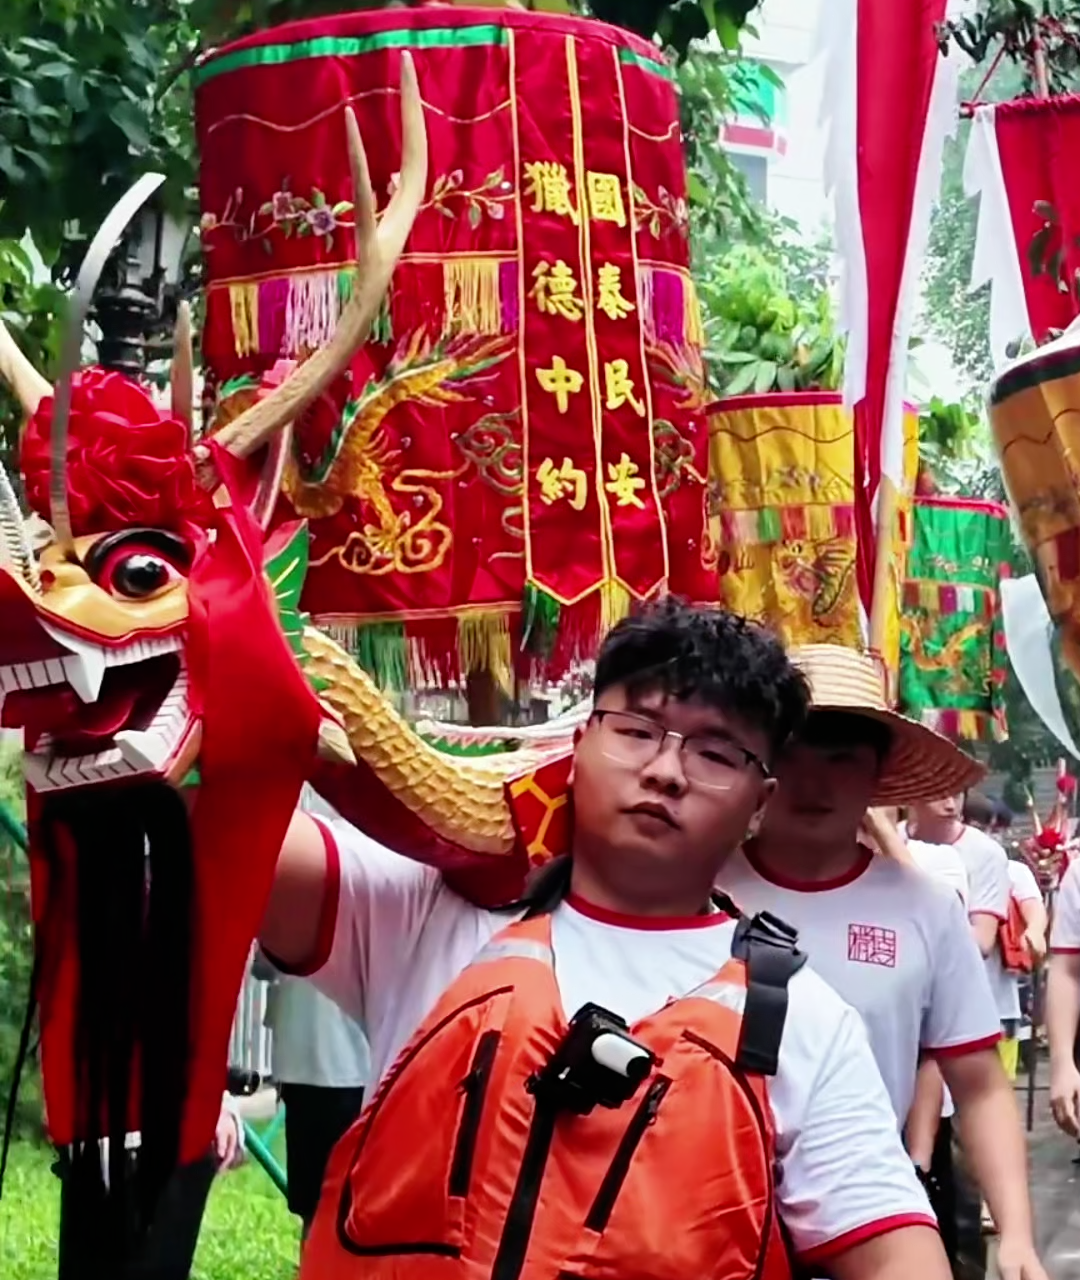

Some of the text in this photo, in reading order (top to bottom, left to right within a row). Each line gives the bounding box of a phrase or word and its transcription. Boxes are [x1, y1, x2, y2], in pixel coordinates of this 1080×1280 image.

[523, 160, 588, 512] 獵德中約
[586, 170, 646, 510] 國泰民安
